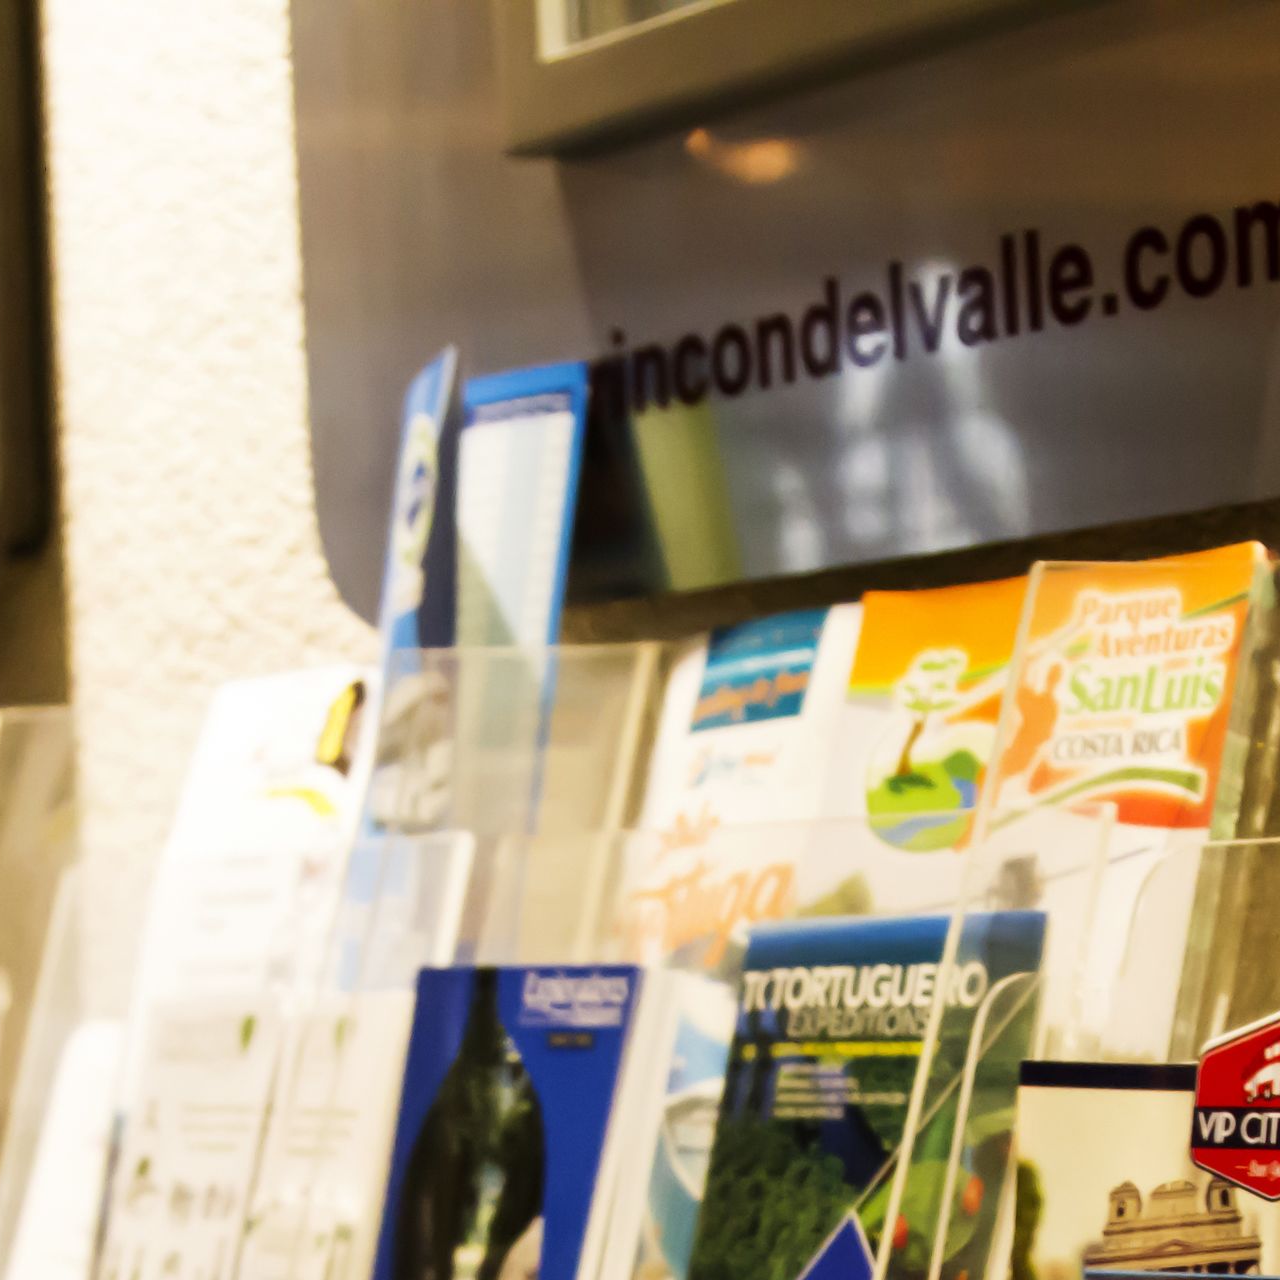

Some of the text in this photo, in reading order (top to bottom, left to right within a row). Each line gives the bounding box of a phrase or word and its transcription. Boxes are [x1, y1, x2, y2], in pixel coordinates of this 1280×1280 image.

[1054, 727, 1182, 761] COSTA RICA
[1198, 1111, 1236, 1144] VIP
